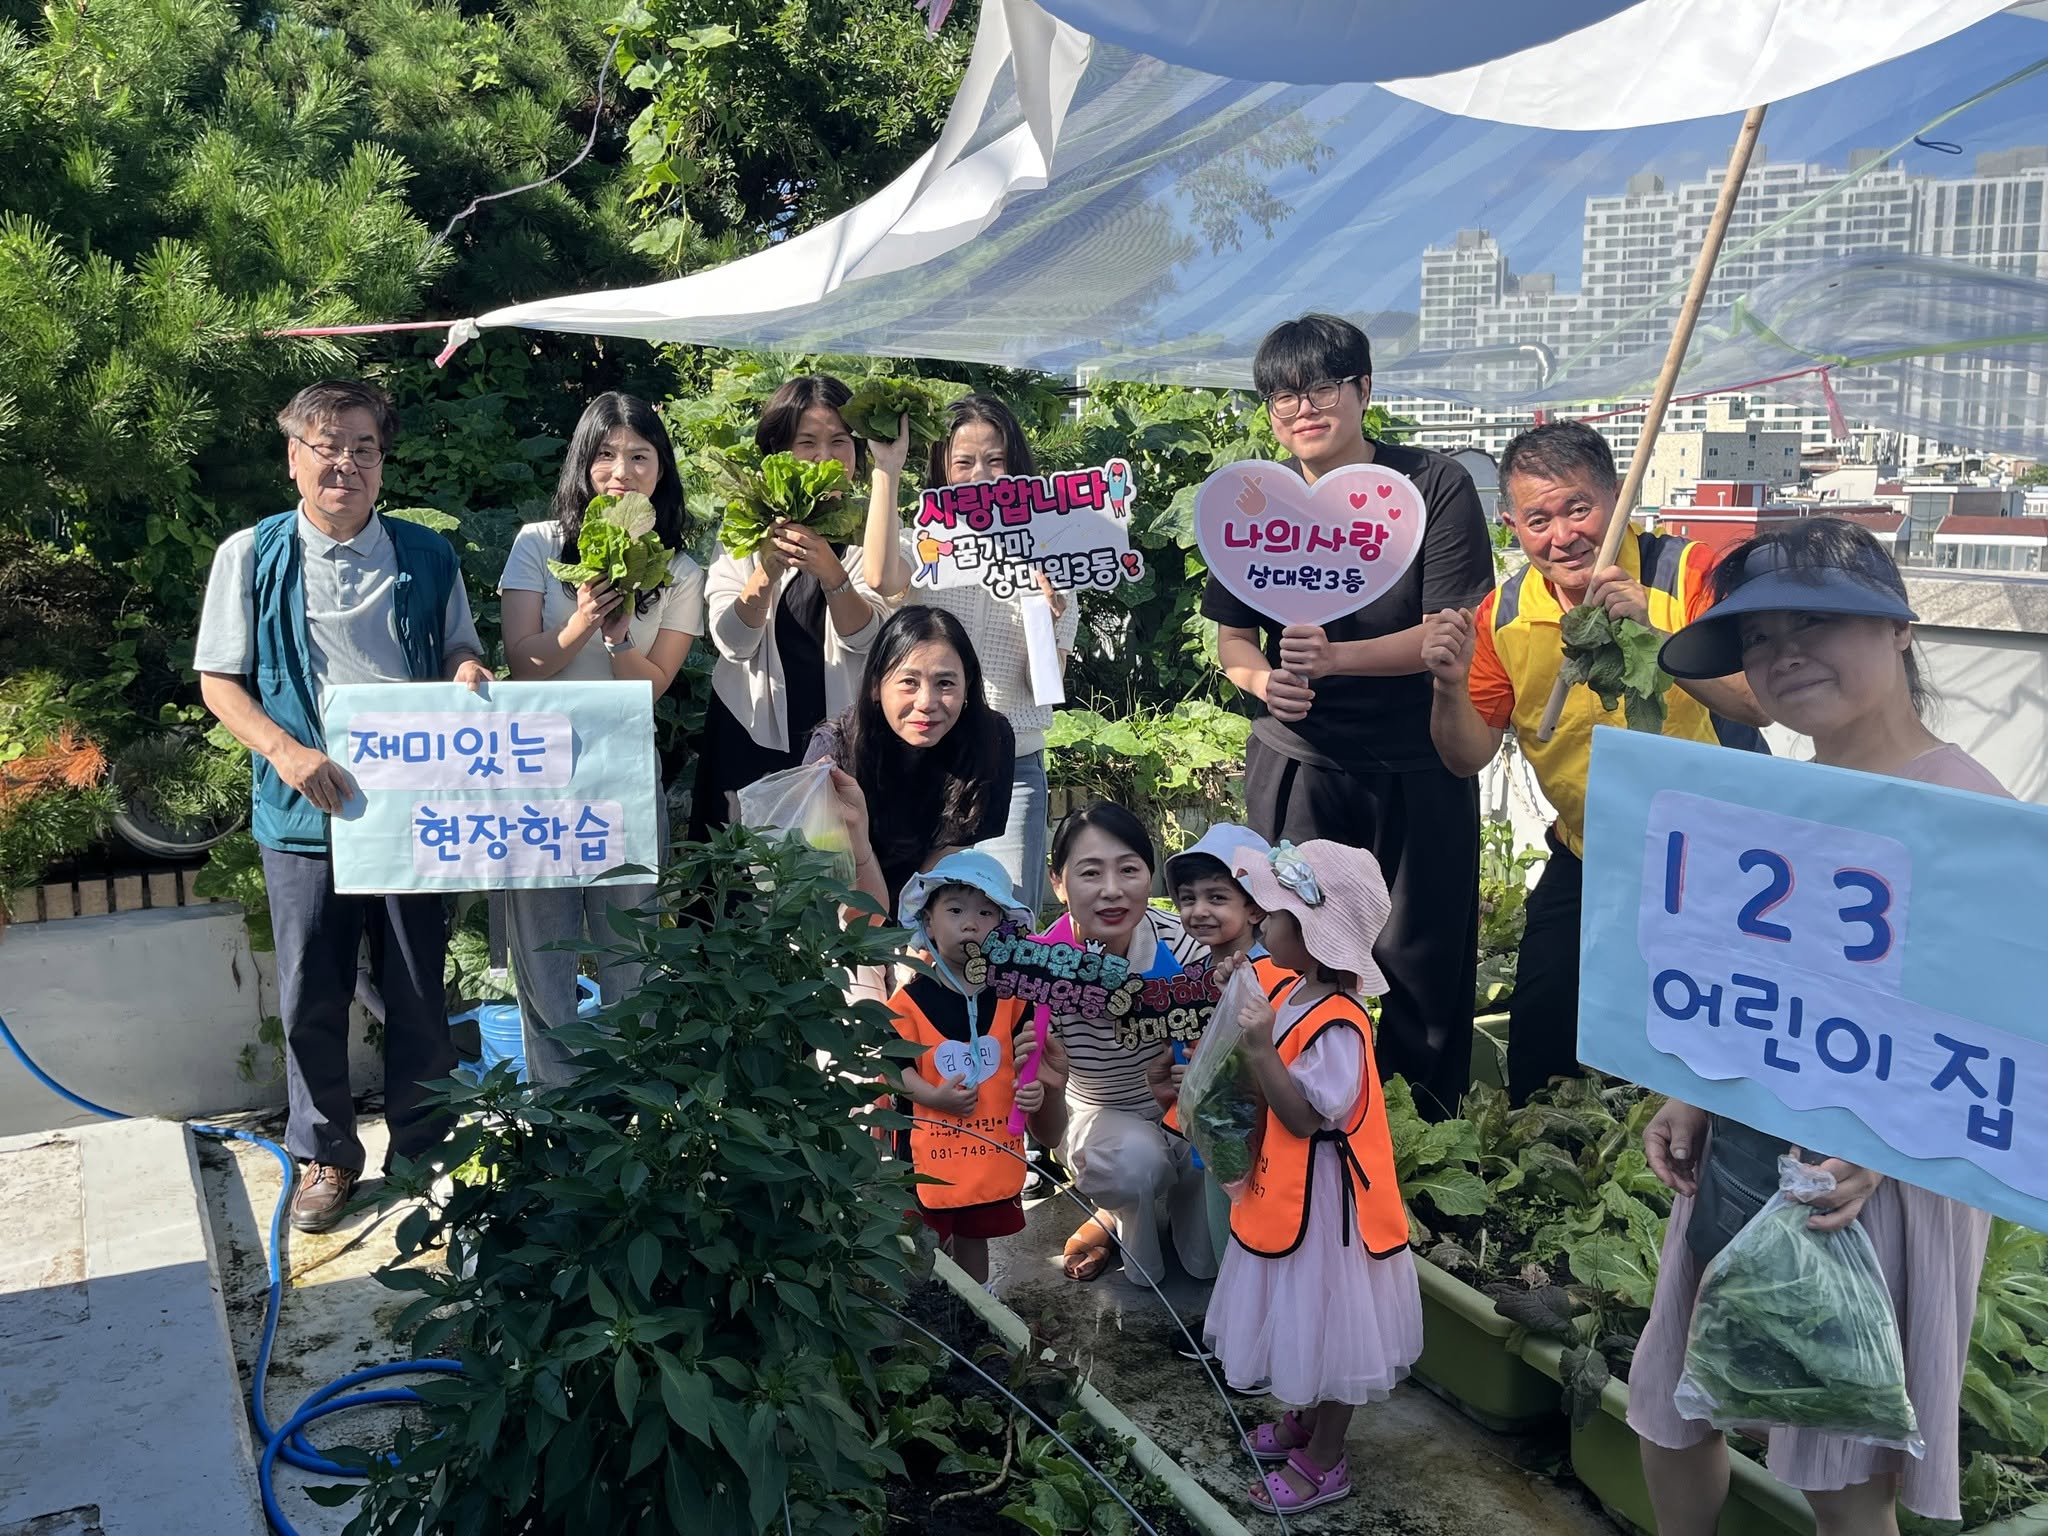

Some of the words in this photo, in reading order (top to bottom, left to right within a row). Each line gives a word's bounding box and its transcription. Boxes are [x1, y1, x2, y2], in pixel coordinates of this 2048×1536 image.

[918, 469, 1108, 531] 사랑합니다
[953, 529, 1034, 570] 꿈가마
[983, 547, 1119, 598] 상대원3동
[1248, 564, 1365, 594] 상대원3동
[350, 722, 546, 778] 재미있는
[415, 804, 610, 862] 현장학습
[981, 931, 1130, 990] 상대원3동
